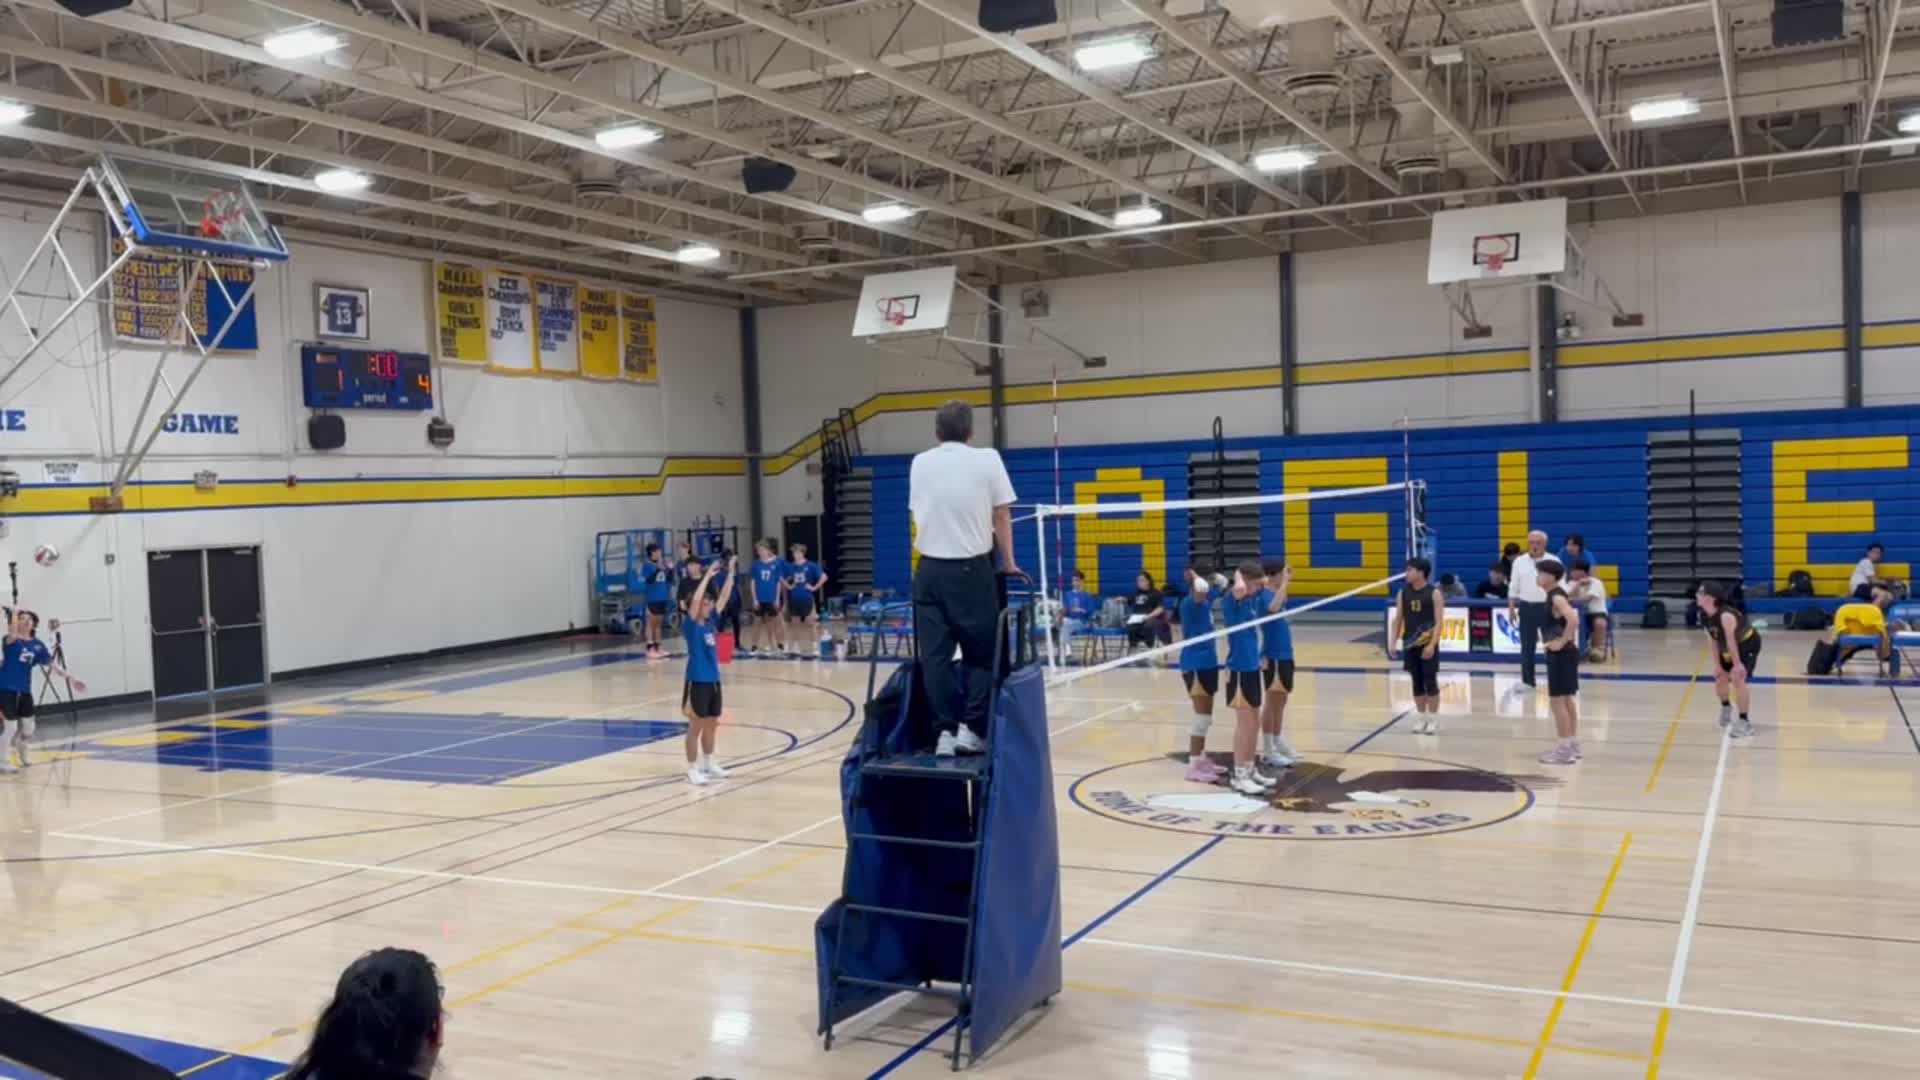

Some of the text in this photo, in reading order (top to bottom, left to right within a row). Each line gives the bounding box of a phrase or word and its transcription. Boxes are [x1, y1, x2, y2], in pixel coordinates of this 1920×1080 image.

[335, 308, 352, 325] 13
[162, 413, 239, 434] GAME
[1147, 812, 1202, 825] OF
[1212, 820, 1296, 835] THE
[1311, 812, 1472, 835] EAGLES
